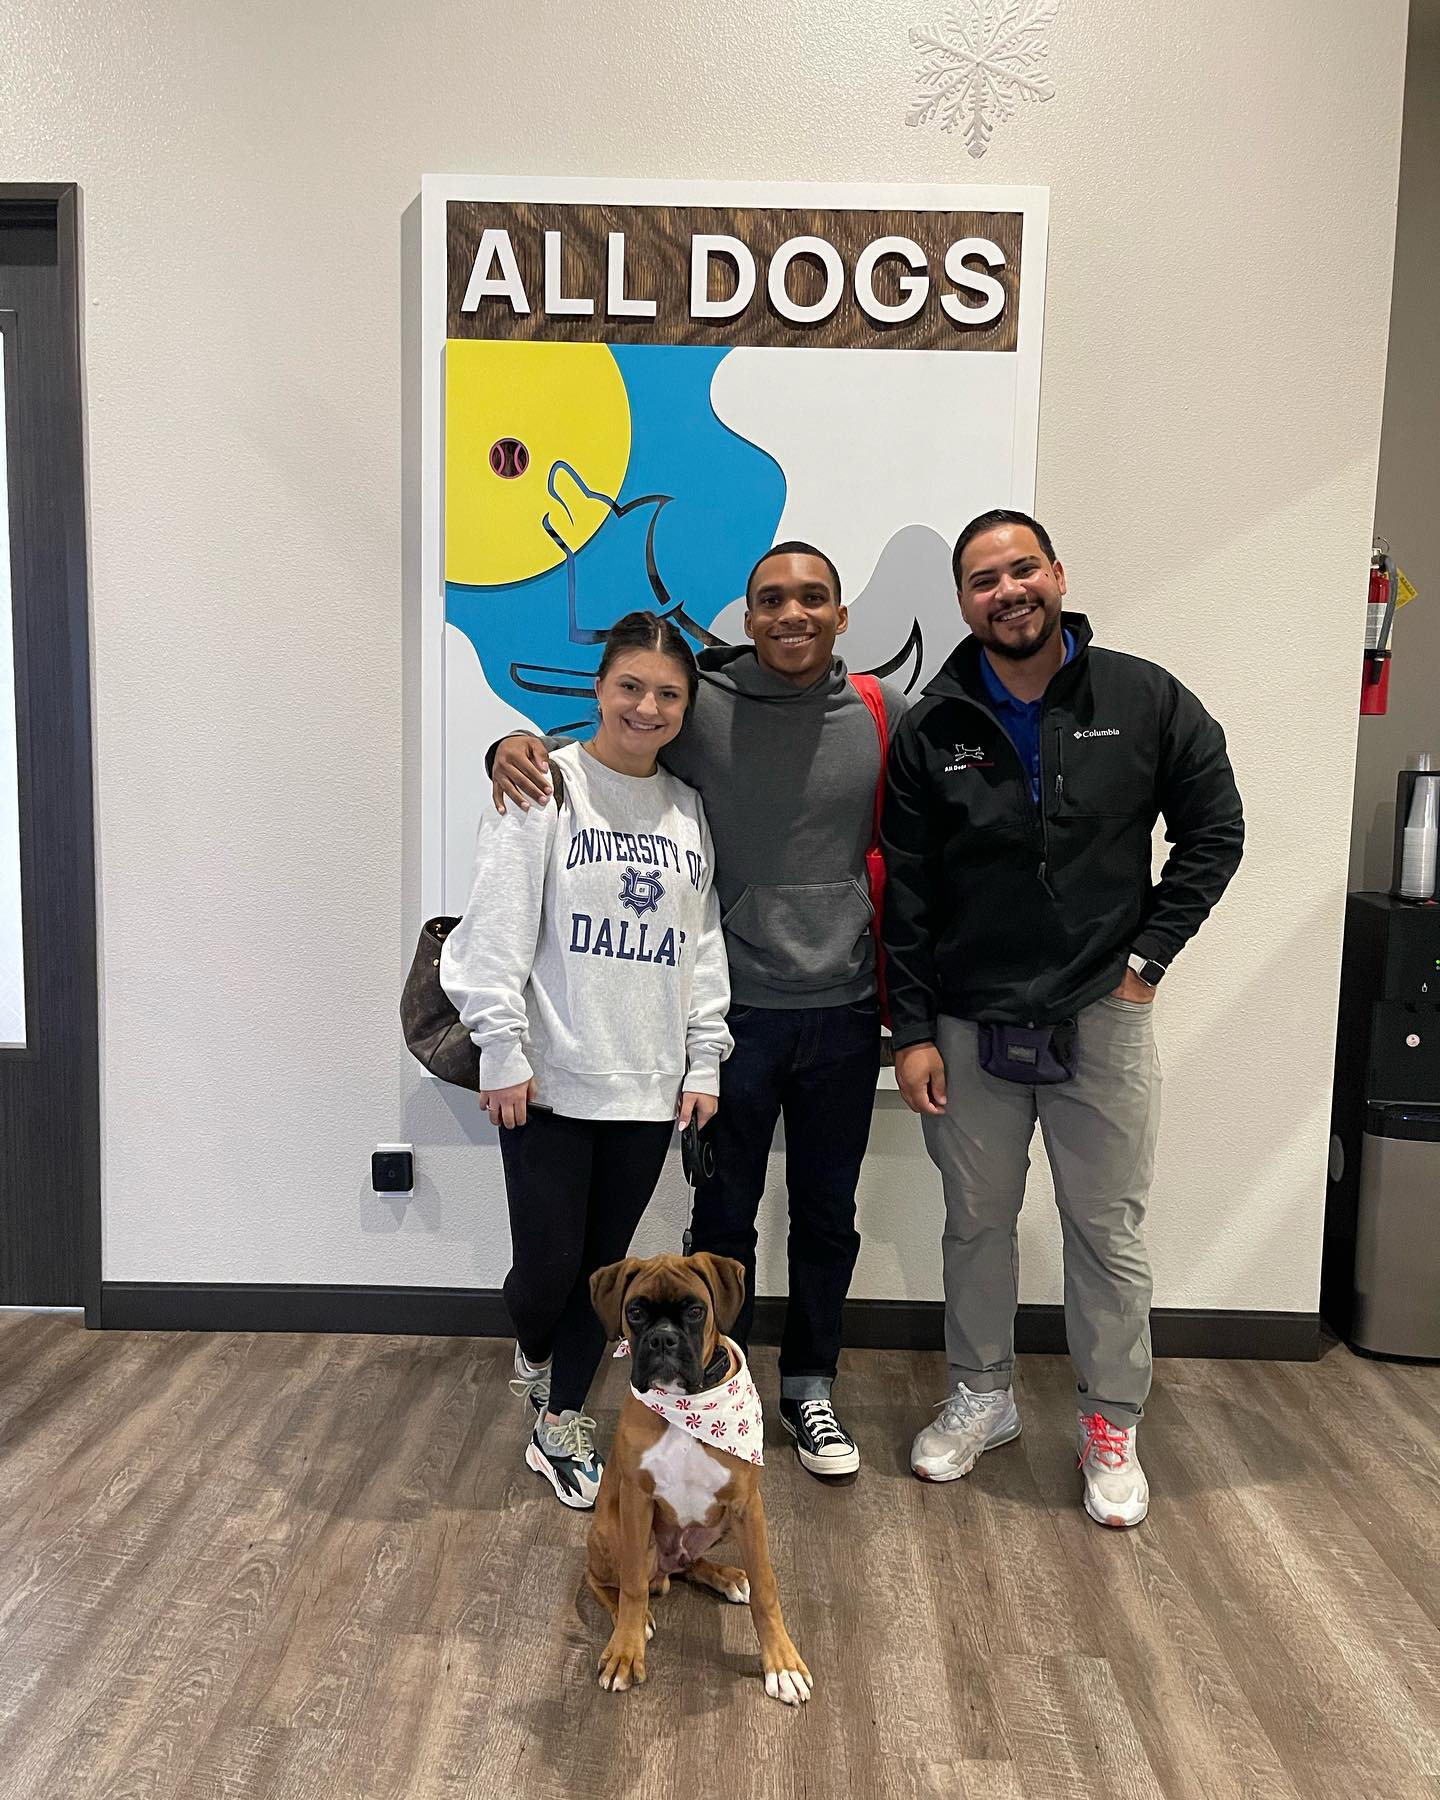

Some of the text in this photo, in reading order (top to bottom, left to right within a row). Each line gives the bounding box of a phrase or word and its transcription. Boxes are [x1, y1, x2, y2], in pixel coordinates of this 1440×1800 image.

[460, 228, 1007, 325] ALL DOGS
[1082, 728, 1120, 738] Columbia
[566, 827, 681, 873] UNIVERSITY
